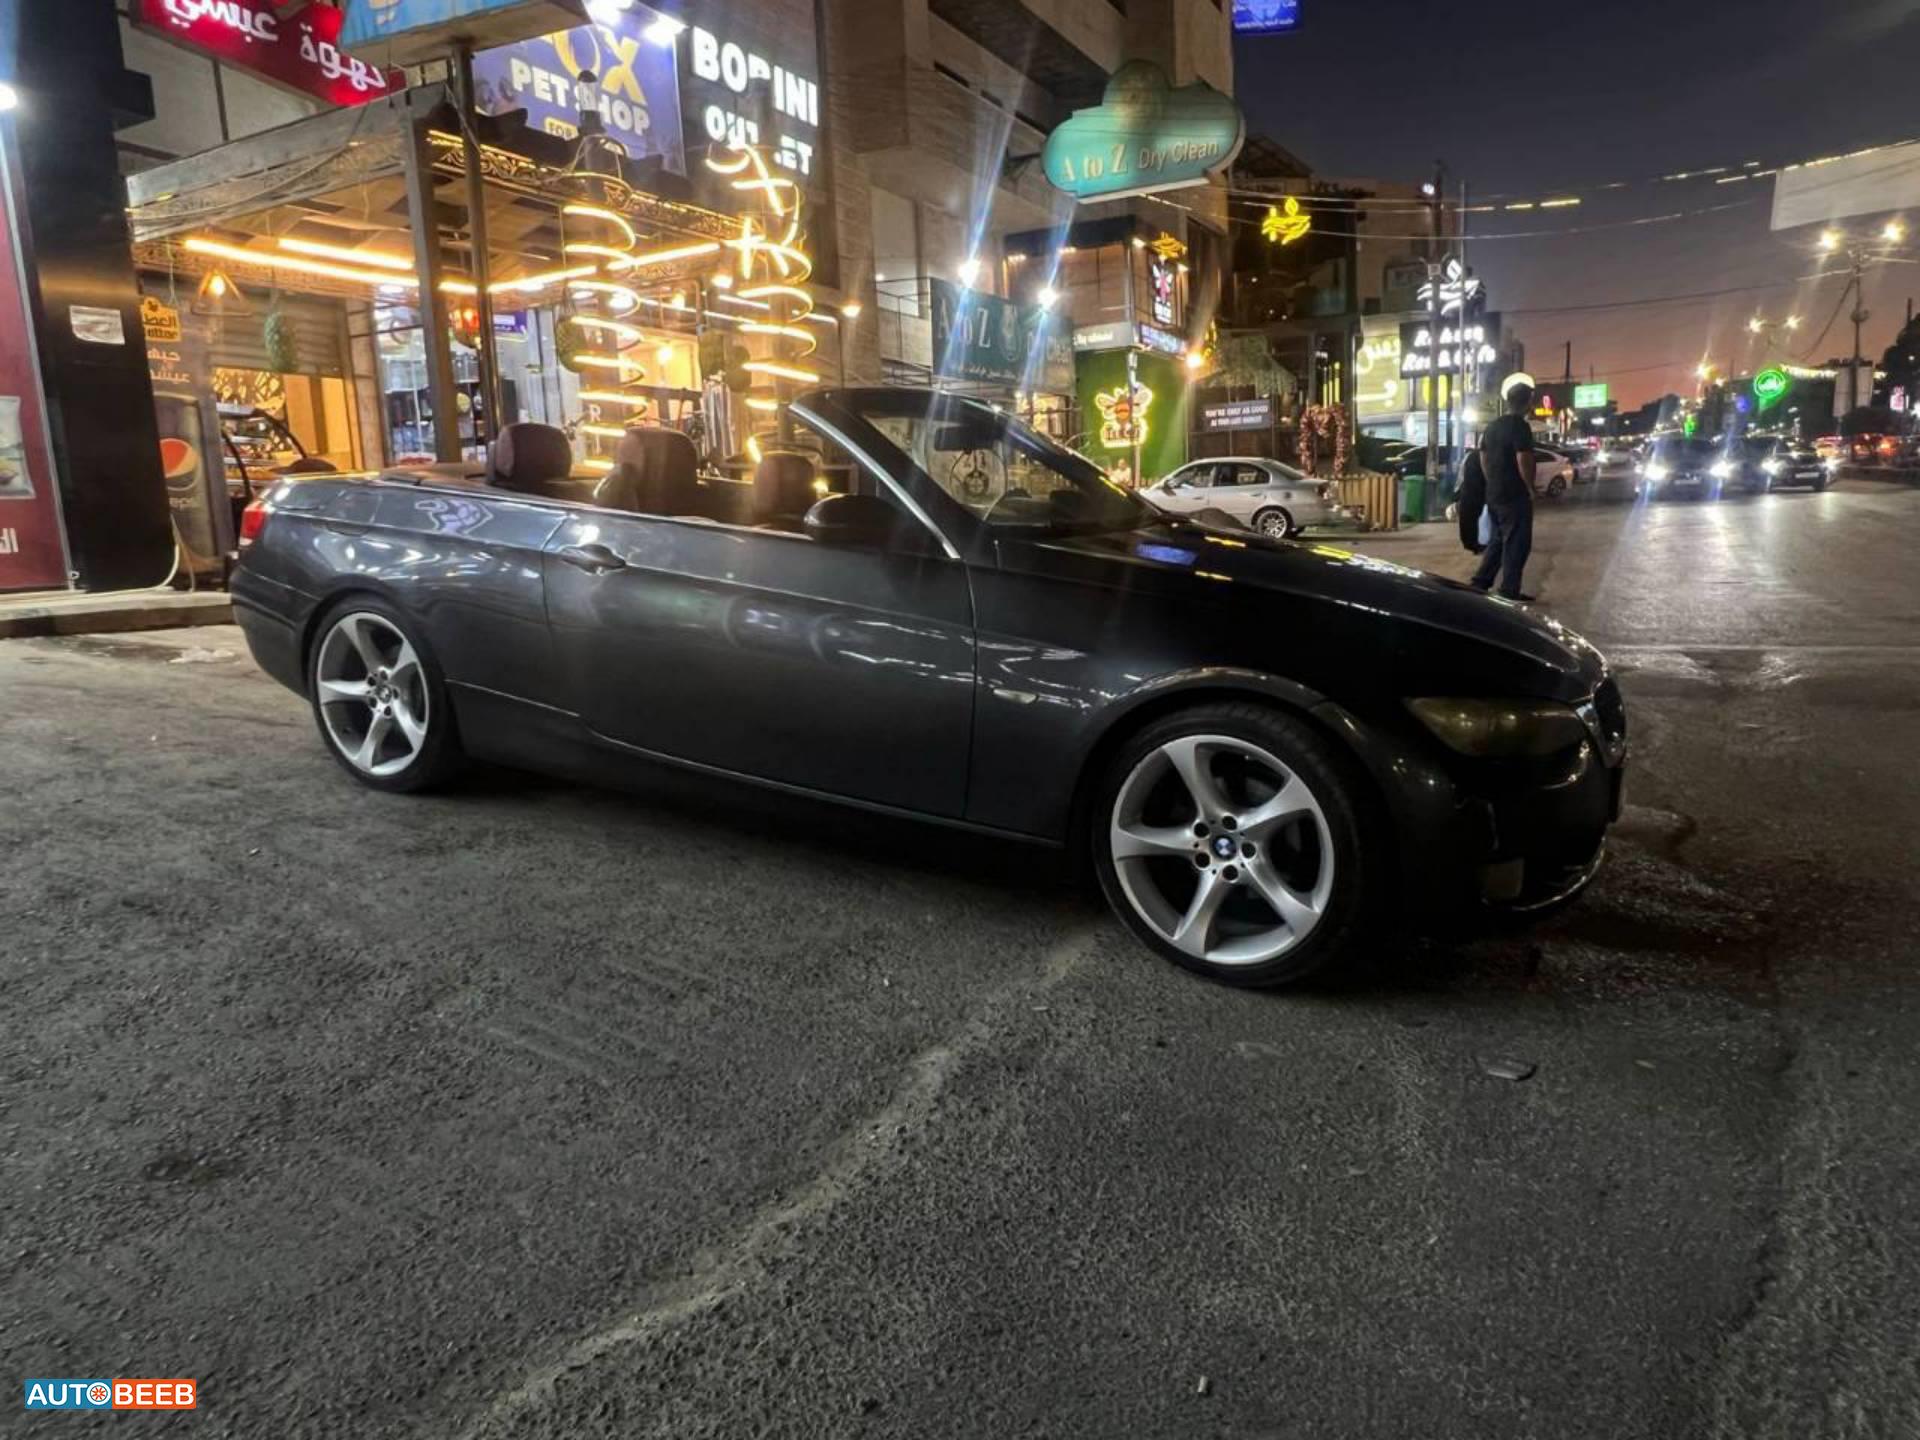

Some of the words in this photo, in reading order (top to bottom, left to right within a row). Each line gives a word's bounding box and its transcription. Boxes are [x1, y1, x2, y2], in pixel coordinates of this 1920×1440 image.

[510, 57, 570, 107] PET
[574, 82, 650, 136] HOP
[1061, 155, 1075, 181] A
[1083, 154, 1104, 179] to
[1111, 143, 1128, 174] Z
[1138, 147, 1166, 172] Dry
[1171, 139, 1218, 163] Clean
[976, 306, 992, 349] Z
